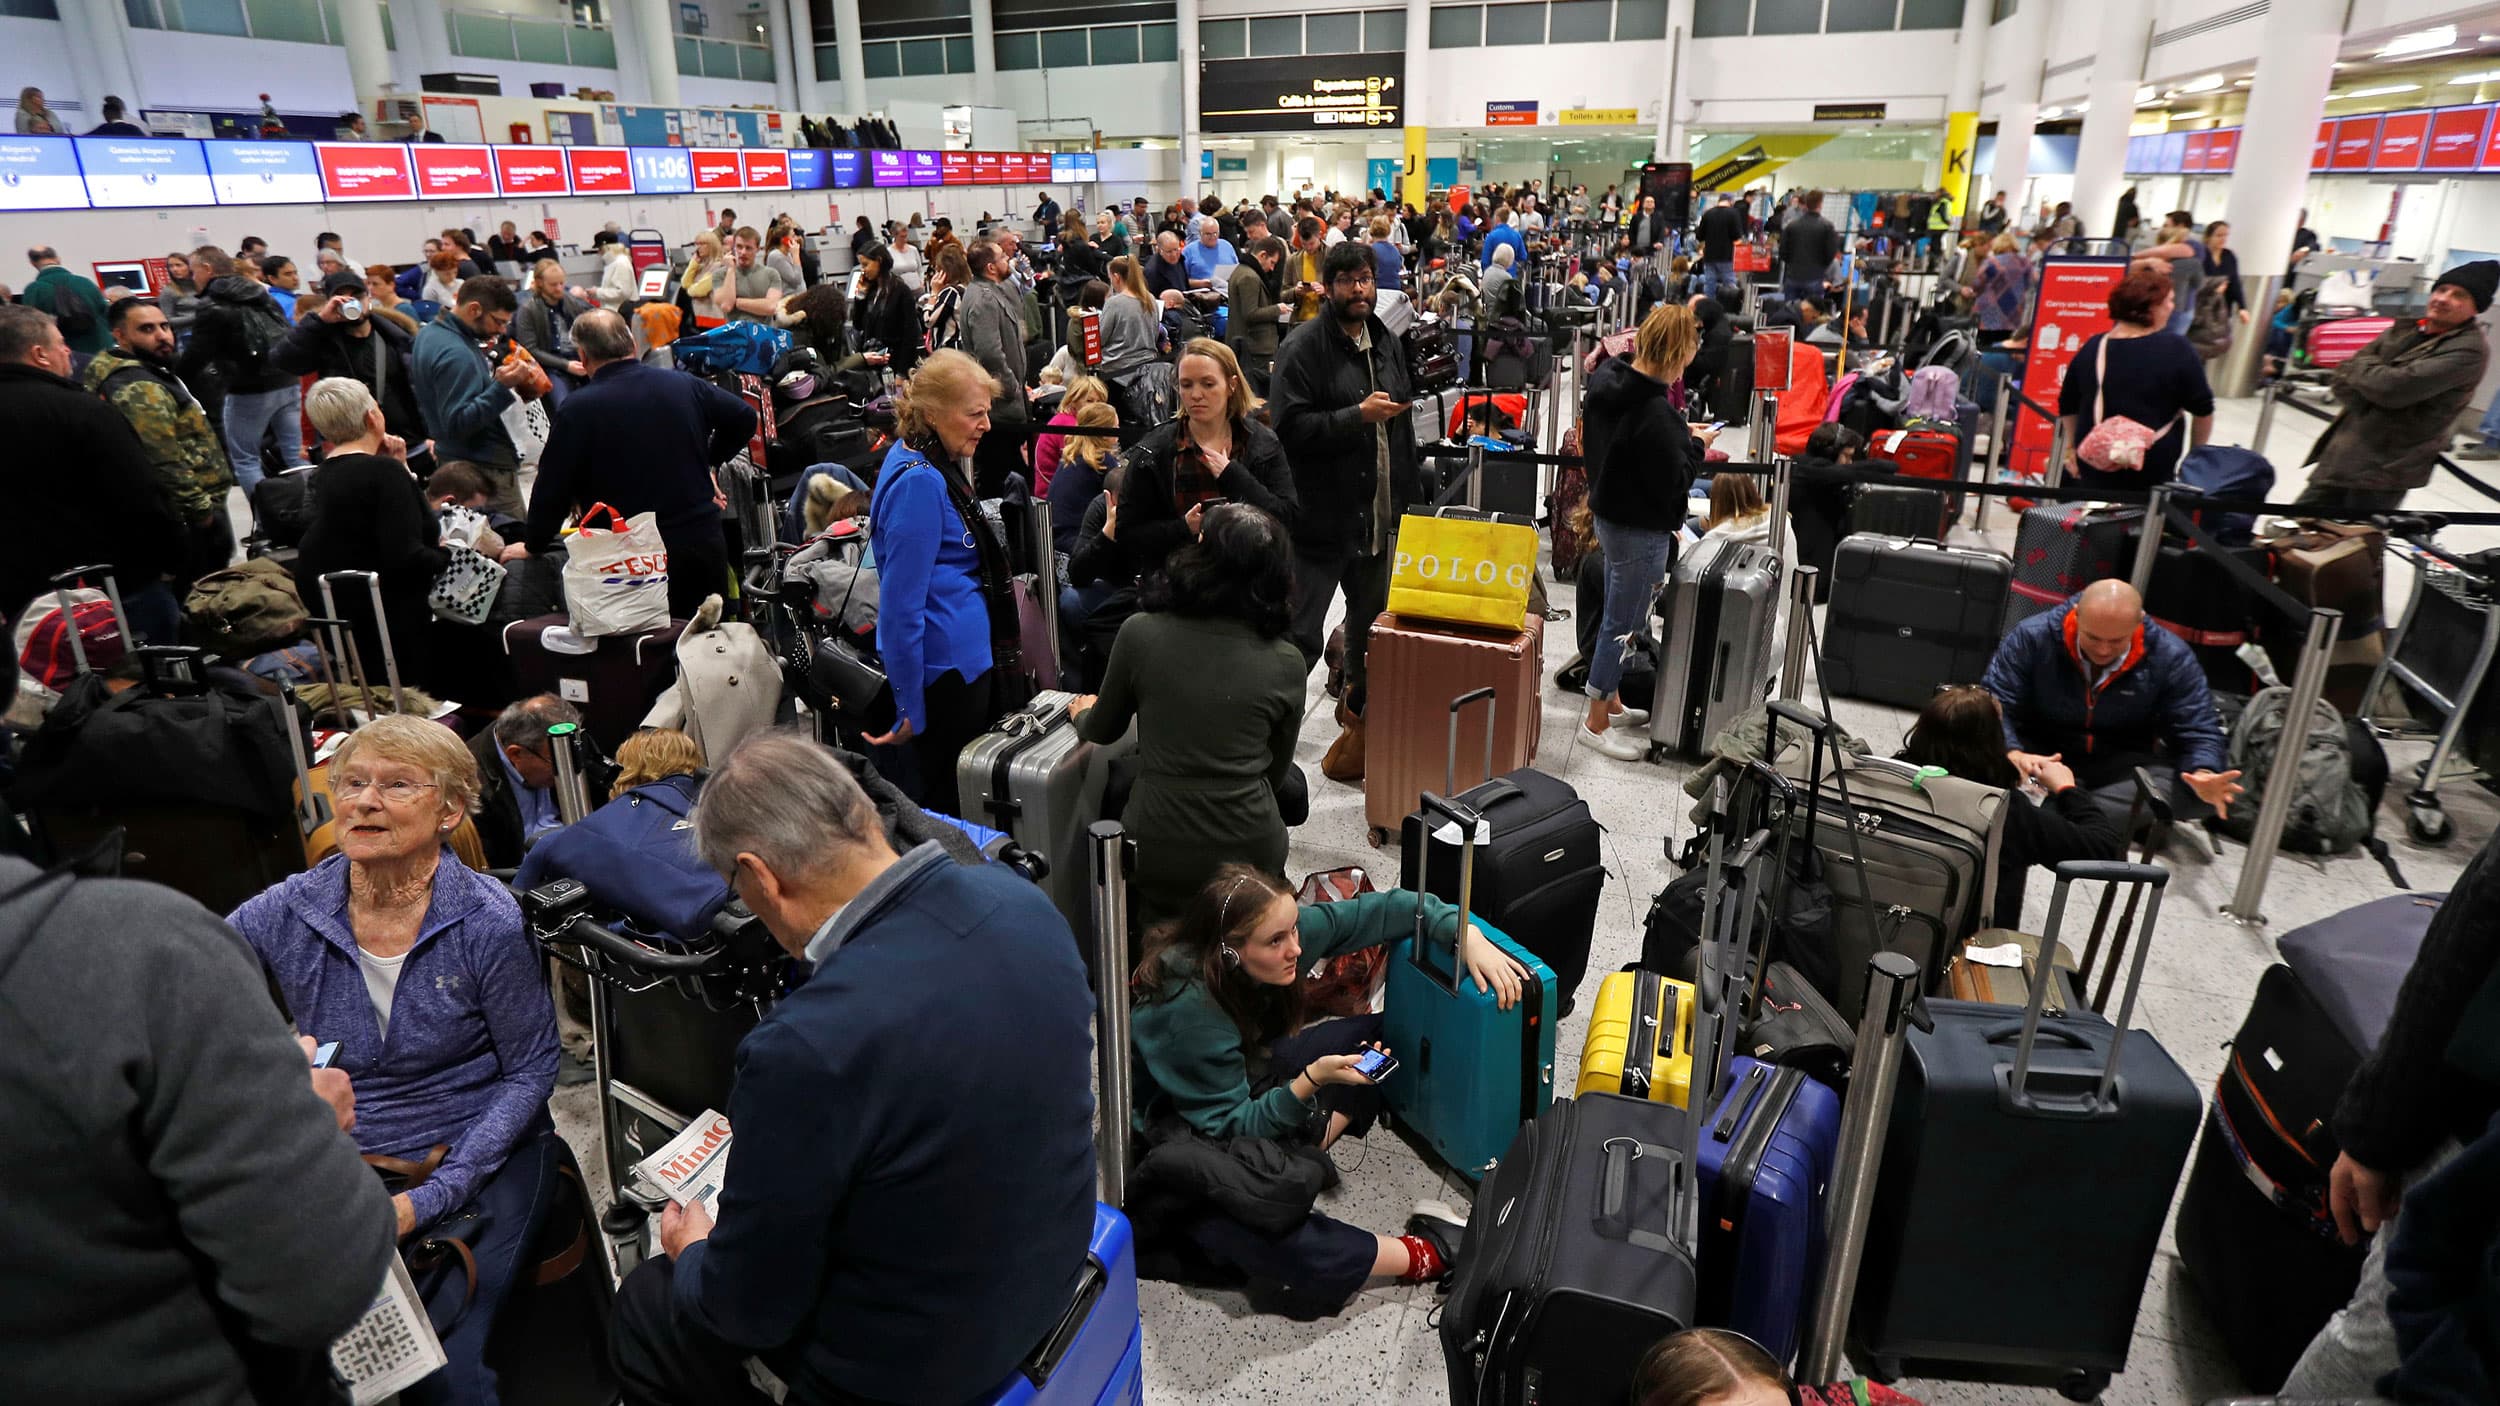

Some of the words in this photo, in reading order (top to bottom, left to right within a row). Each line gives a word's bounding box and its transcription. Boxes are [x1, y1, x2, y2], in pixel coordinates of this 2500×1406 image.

[1339, 111, 1366, 123] Hotel
[1406, 154, 1415, 176] J
[1948, 148, 1968, 173] K
[336, 166, 397, 177] norwegian
[428, 166, 482, 177] norwegian
[508, 166, 556, 176] norwegian
[580, 166, 622, 176] norwegian
[636, 156, 688, 179] 11:06
[1694, 164, 1739, 192] Departures
[2056, 274, 2109, 284] norwegian
